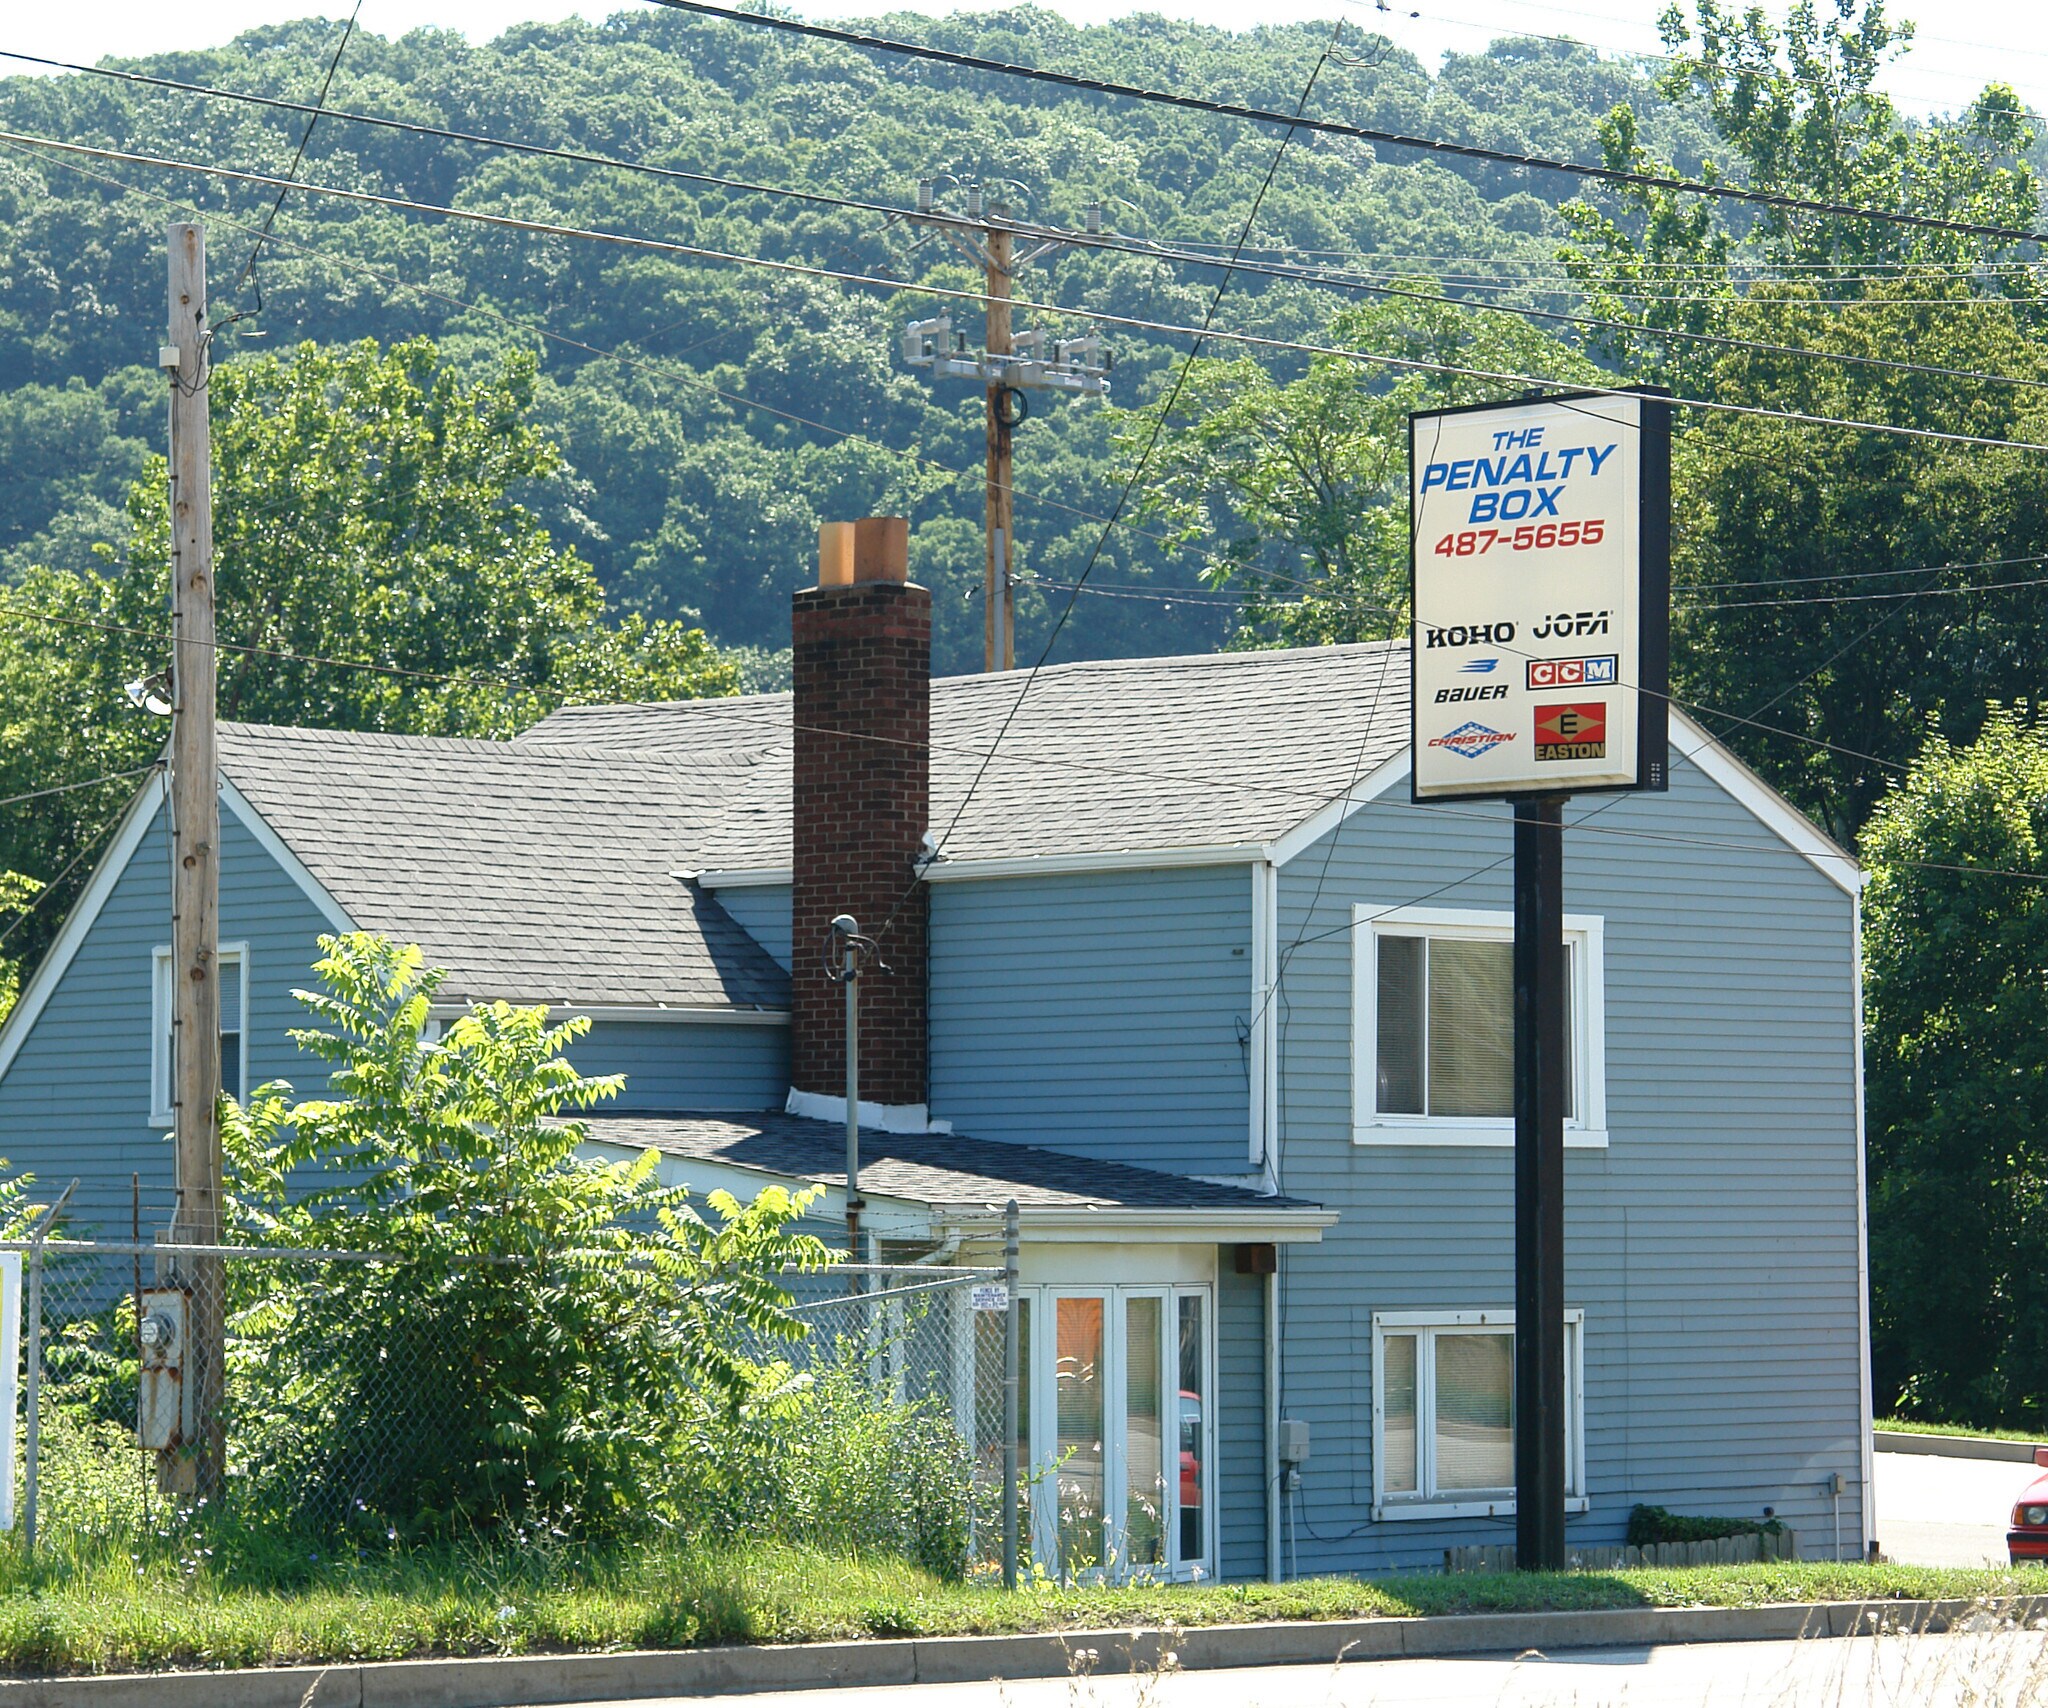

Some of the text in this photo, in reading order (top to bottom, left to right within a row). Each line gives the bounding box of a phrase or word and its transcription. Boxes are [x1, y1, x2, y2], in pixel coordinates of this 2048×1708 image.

[1492, 426, 1545, 452] THE
[1420, 444, 1618, 495] PENALTY
[1468, 485, 1567, 524] BOX
[1434, 519, 1605, 558] 487-5655
[1426, 622, 1516, 649] KOHO
[1532, 611, 1610, 640] JOFA
[1533, 659, 1613, 686] CCM
[1560, 713, 1578, 735] E
[1428, 732, 1517, 747] CHRISTIAN
[1535, 743, 1606, 760] EASTON
